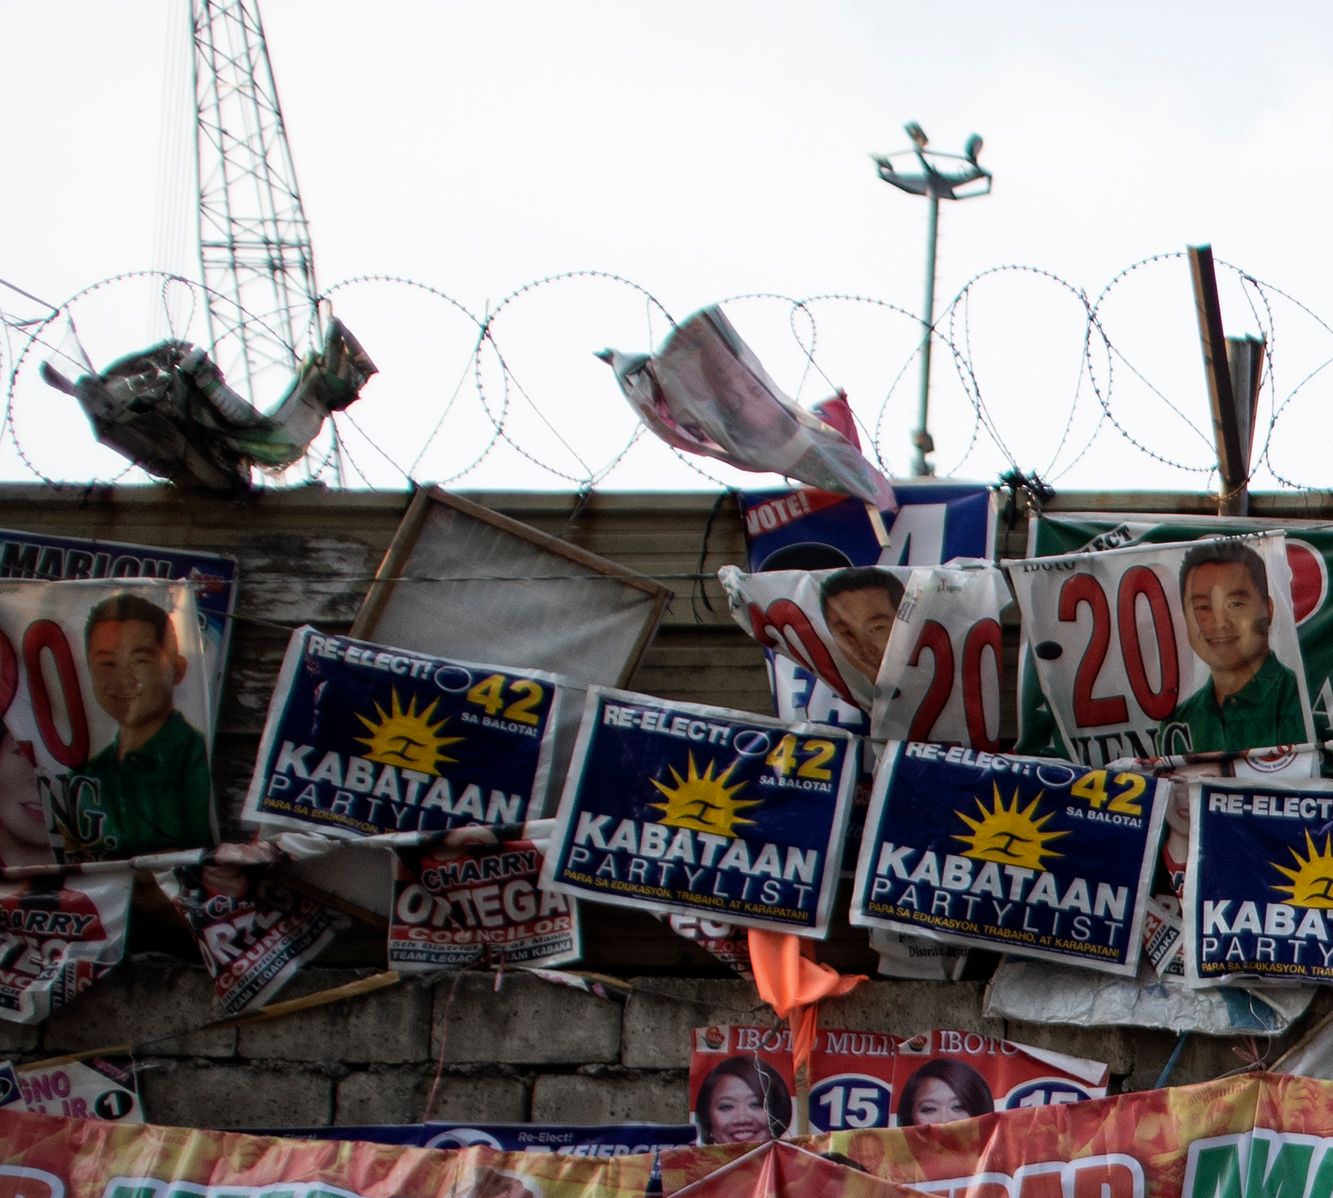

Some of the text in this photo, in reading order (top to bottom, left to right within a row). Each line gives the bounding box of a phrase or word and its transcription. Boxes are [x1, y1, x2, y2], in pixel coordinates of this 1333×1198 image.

[1058, 565, 1180, 728] 20
[308, 636, 544, 726] RE-ELECT! 42
[603, 704, 837, 781] RE-ELECT! 42
[273, 741, 521, 824] KABATAAN
[1069, 769, 1147, 817] 42
[421, 849, 539, 892] CHARRY
[567, 847, 814, 910] PARTYLIST
[573, 814, 819, 884] KABATAAN
[876, 842, 1129, 922] KABATAAN
[562, 869, 810, 923] PARA EDUKASYON, TRABAHO, AT KARAPATAN!
[870, 877, 1126, 947] PARTYLIST
[868, 901, 894, 917] PARA
[912, 911, 981, 936] EDUKASYON,
[983, 924, 1036, 944] TRABAHO,
[1039, 933, 1052, 946] AT
[1053, 937, 1120, 959] KARAPATAN!
[827, 1034, 897, 1057] MULI!
[819, 1086, 879, 1128] 15
